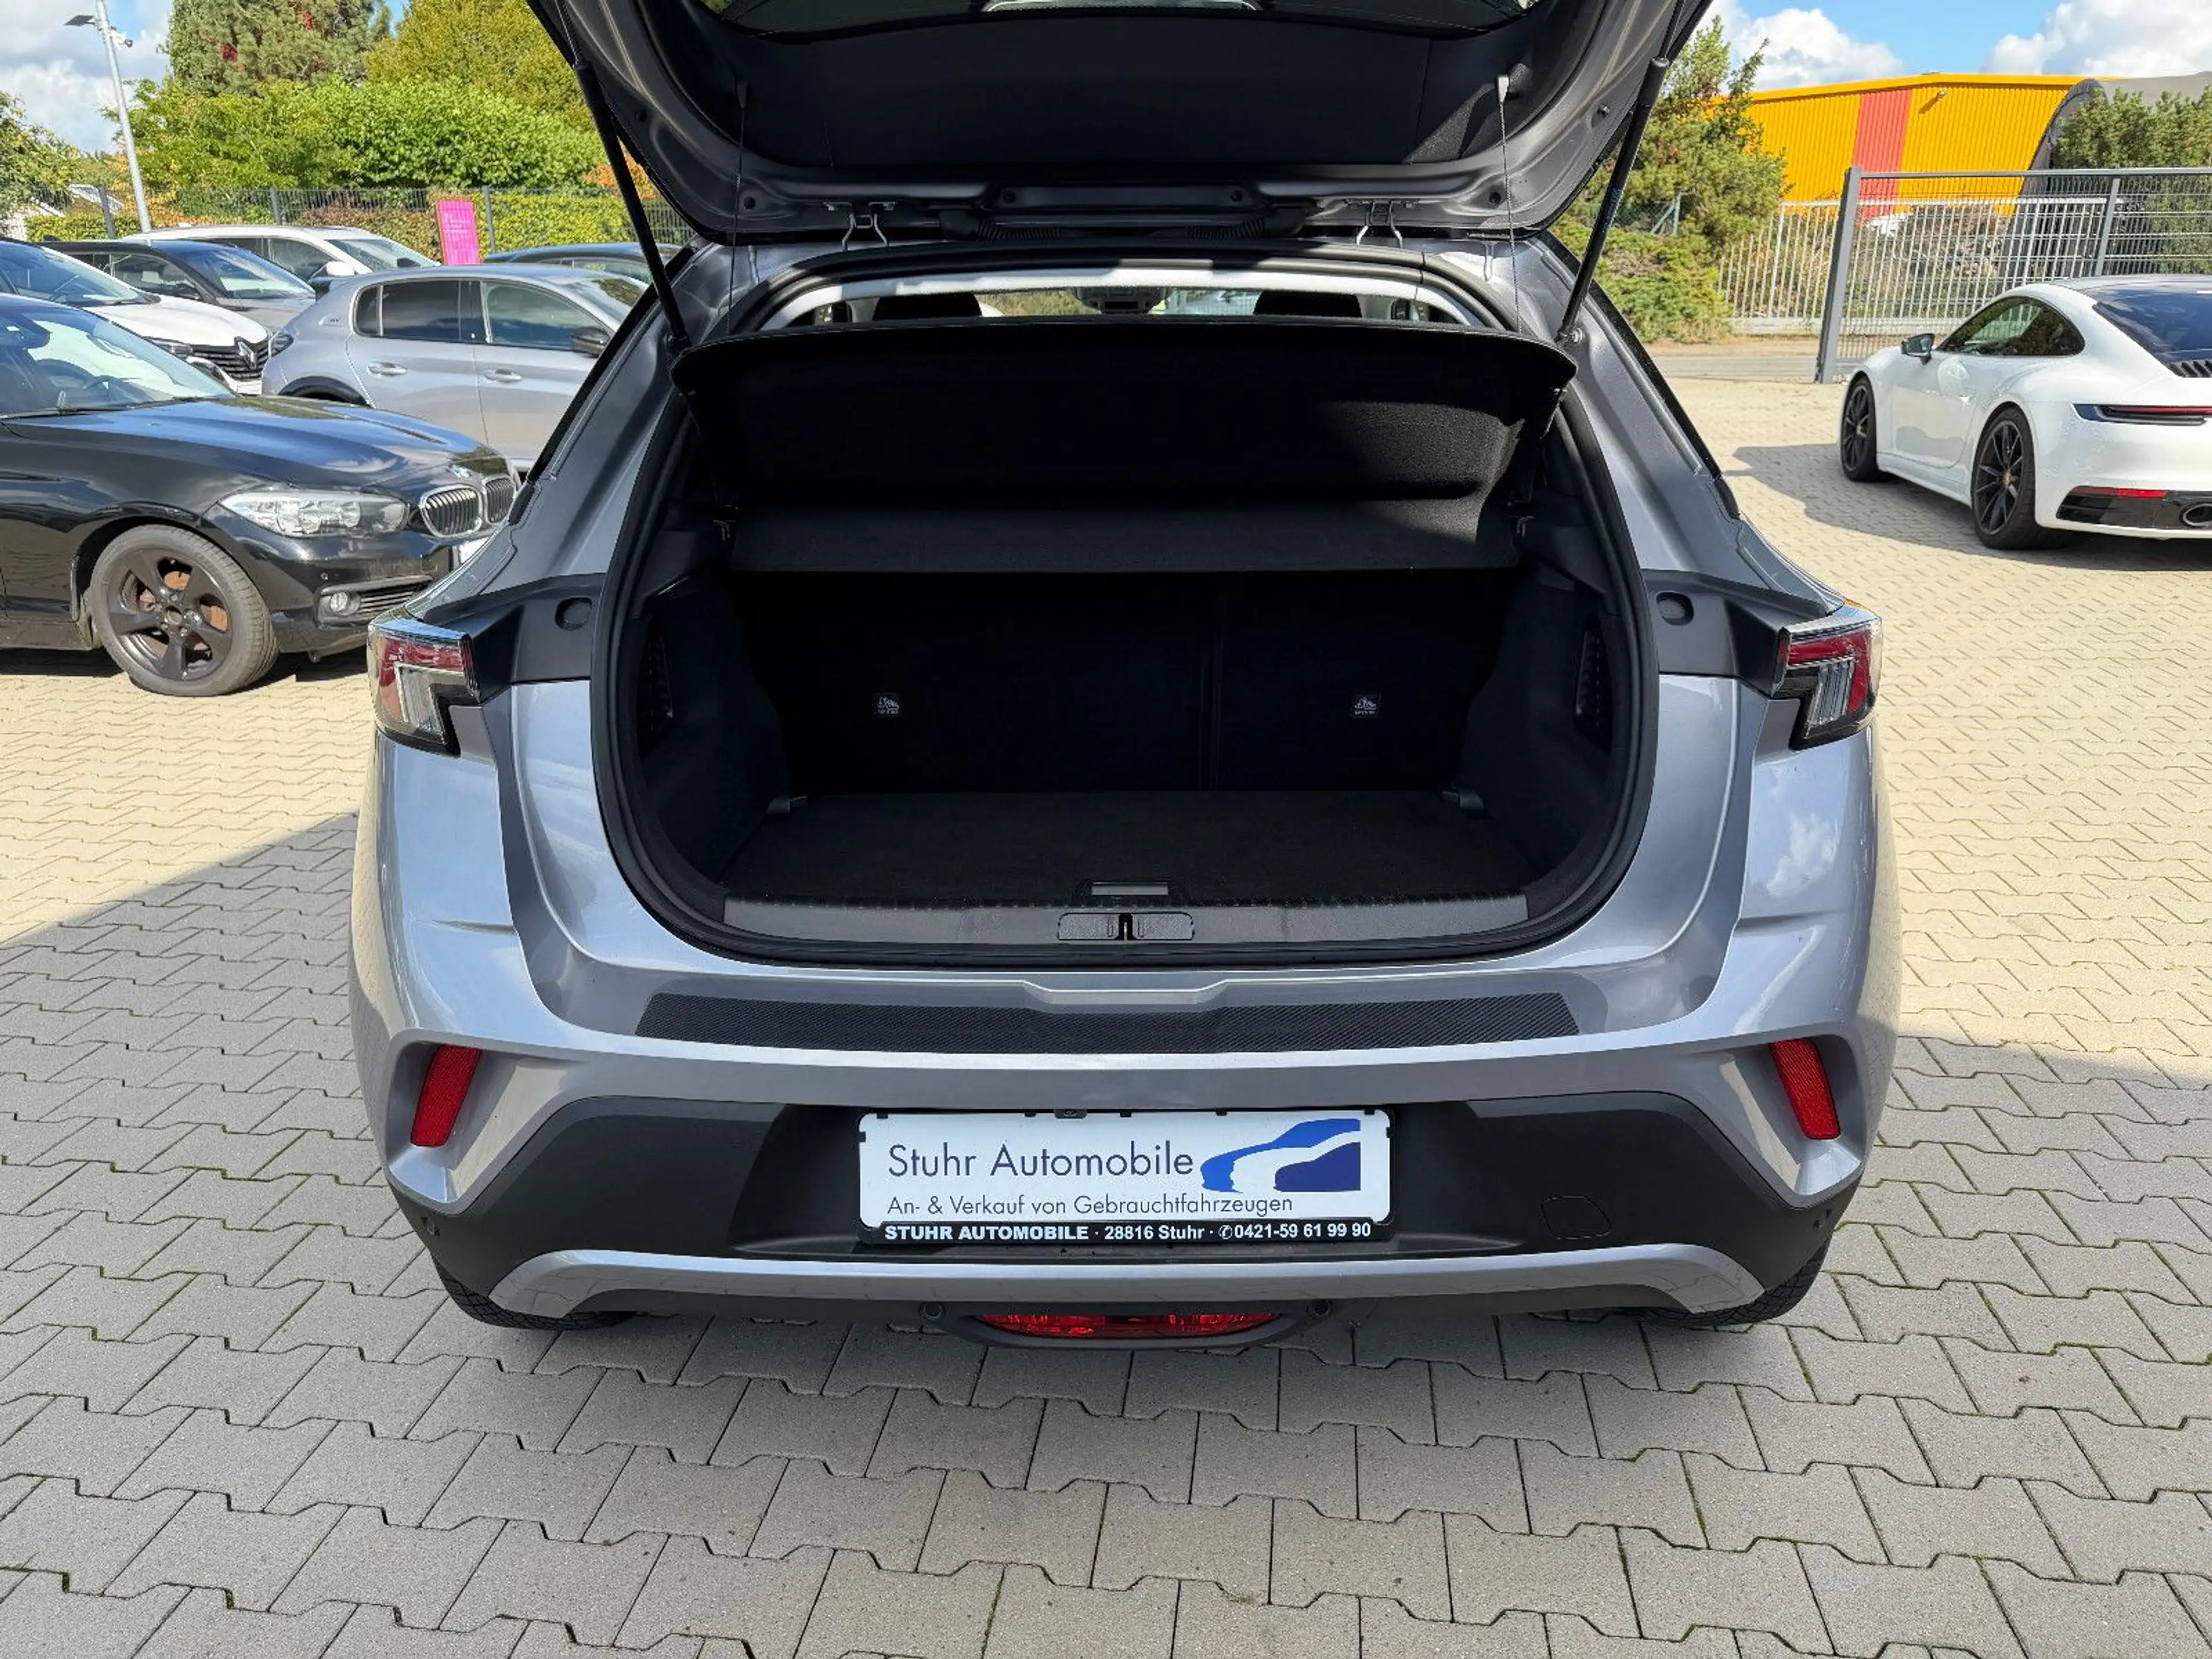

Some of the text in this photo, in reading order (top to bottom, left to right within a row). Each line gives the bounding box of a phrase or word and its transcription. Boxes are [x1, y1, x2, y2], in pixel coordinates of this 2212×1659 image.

[888, 1141, 1194, 1177] Stuhr Automobile
[887, 1193, 1293, 1217] An- & Verkauf von Gebrauchtfahrzeugen
[885, 1226, 953, 1240] STUHR
[958, 1226, 1089, 1240] AUTOMOBILE
[1104, 1225, 1154, 1240] 28816
[1158, 1225, 1205, 1240] Stuhr
[1303, 1223, 1321, 1238] 61
[1327, 1222, 1347, 1237] 99
[1351, 1222, 1371, 1237] 90
